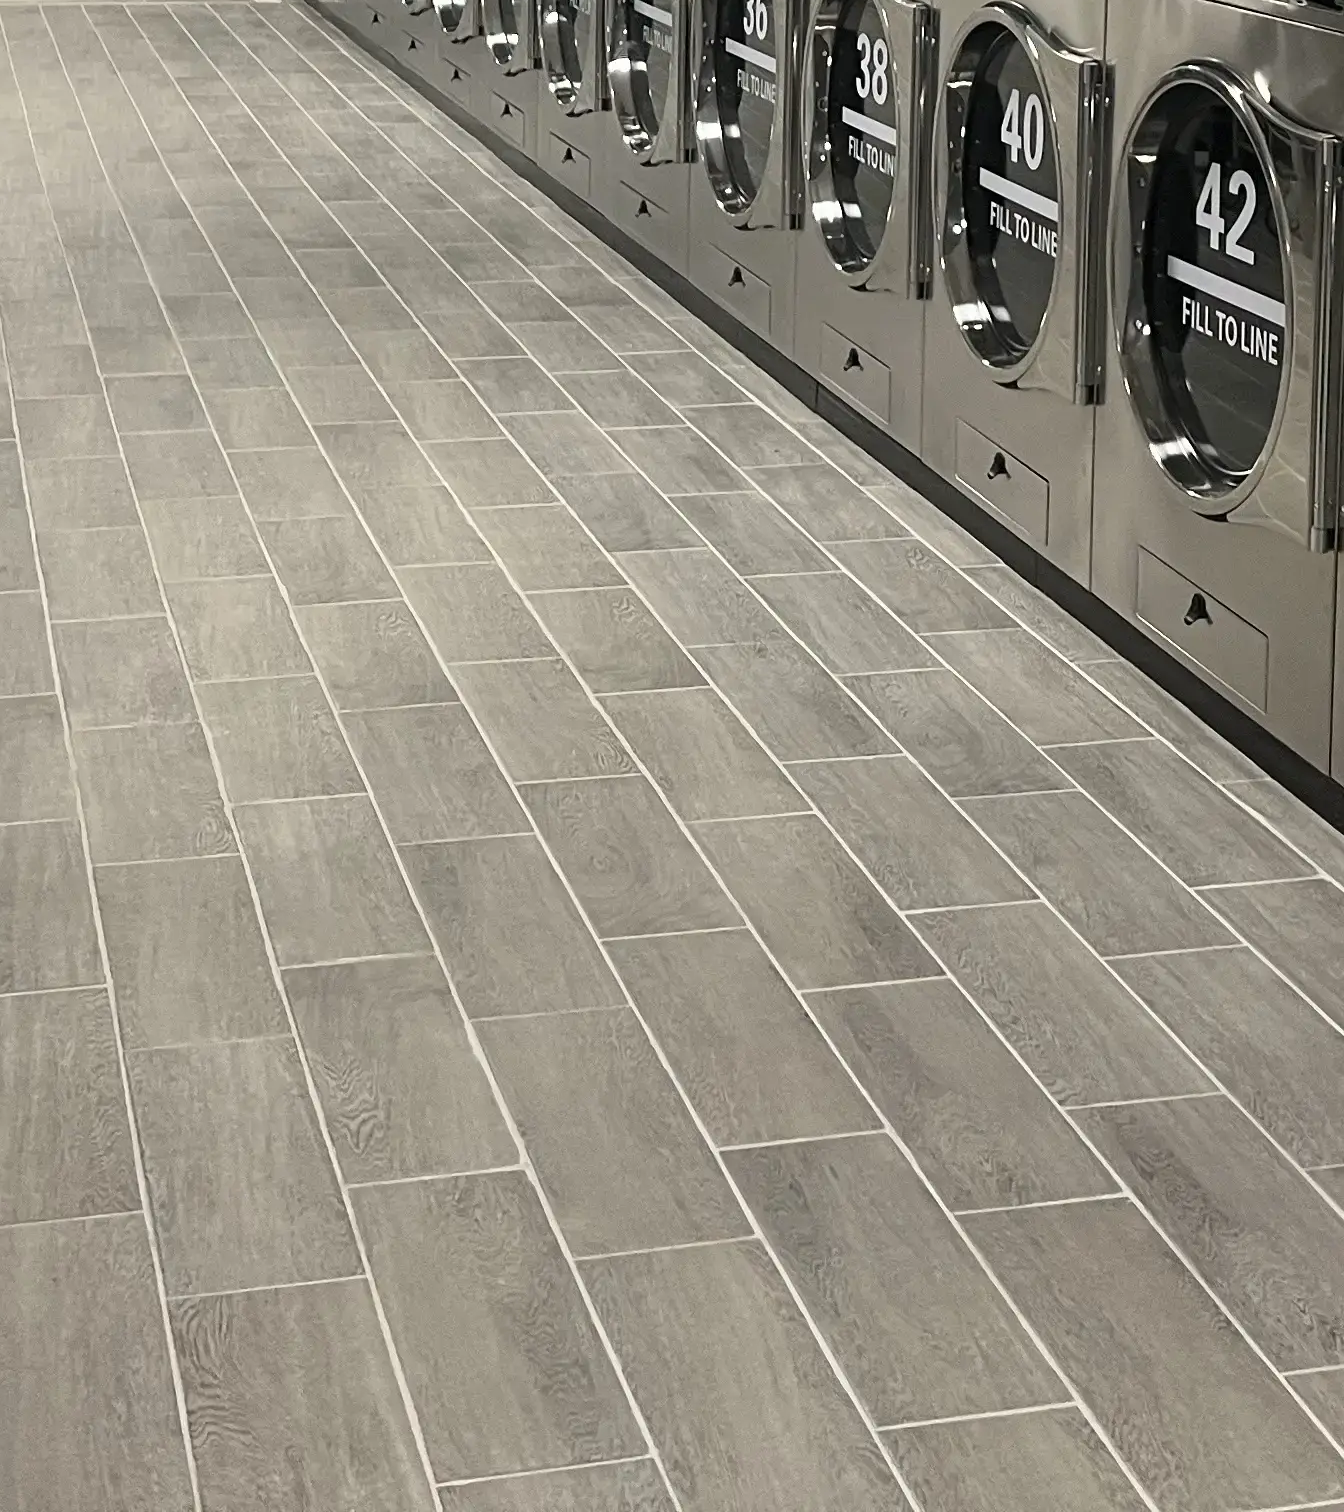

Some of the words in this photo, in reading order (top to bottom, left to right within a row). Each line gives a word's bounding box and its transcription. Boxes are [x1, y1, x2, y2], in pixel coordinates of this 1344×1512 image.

[737, 68, 750, 92] FILL
[751, 74, 759, 96] TO
[855, 32, 889, 105] 38
[848, 135, 865, 164] FILL
[865, 142, 878, 169] TO
[878, 149, 895, 177] LIN
[1000, 88, 1045, 172] 40
[990, 200, 1013, 236] FILL
[1013, 212, 1030, 243] TO
[1031, 221, 1058, 258] LINE
[1195, 161, 1256, 267] 42
[1181, 296, 1215, 337] FILL
[1216, 310, 1238, 347] TO
[1240, 319, 1279, 367] LINE
